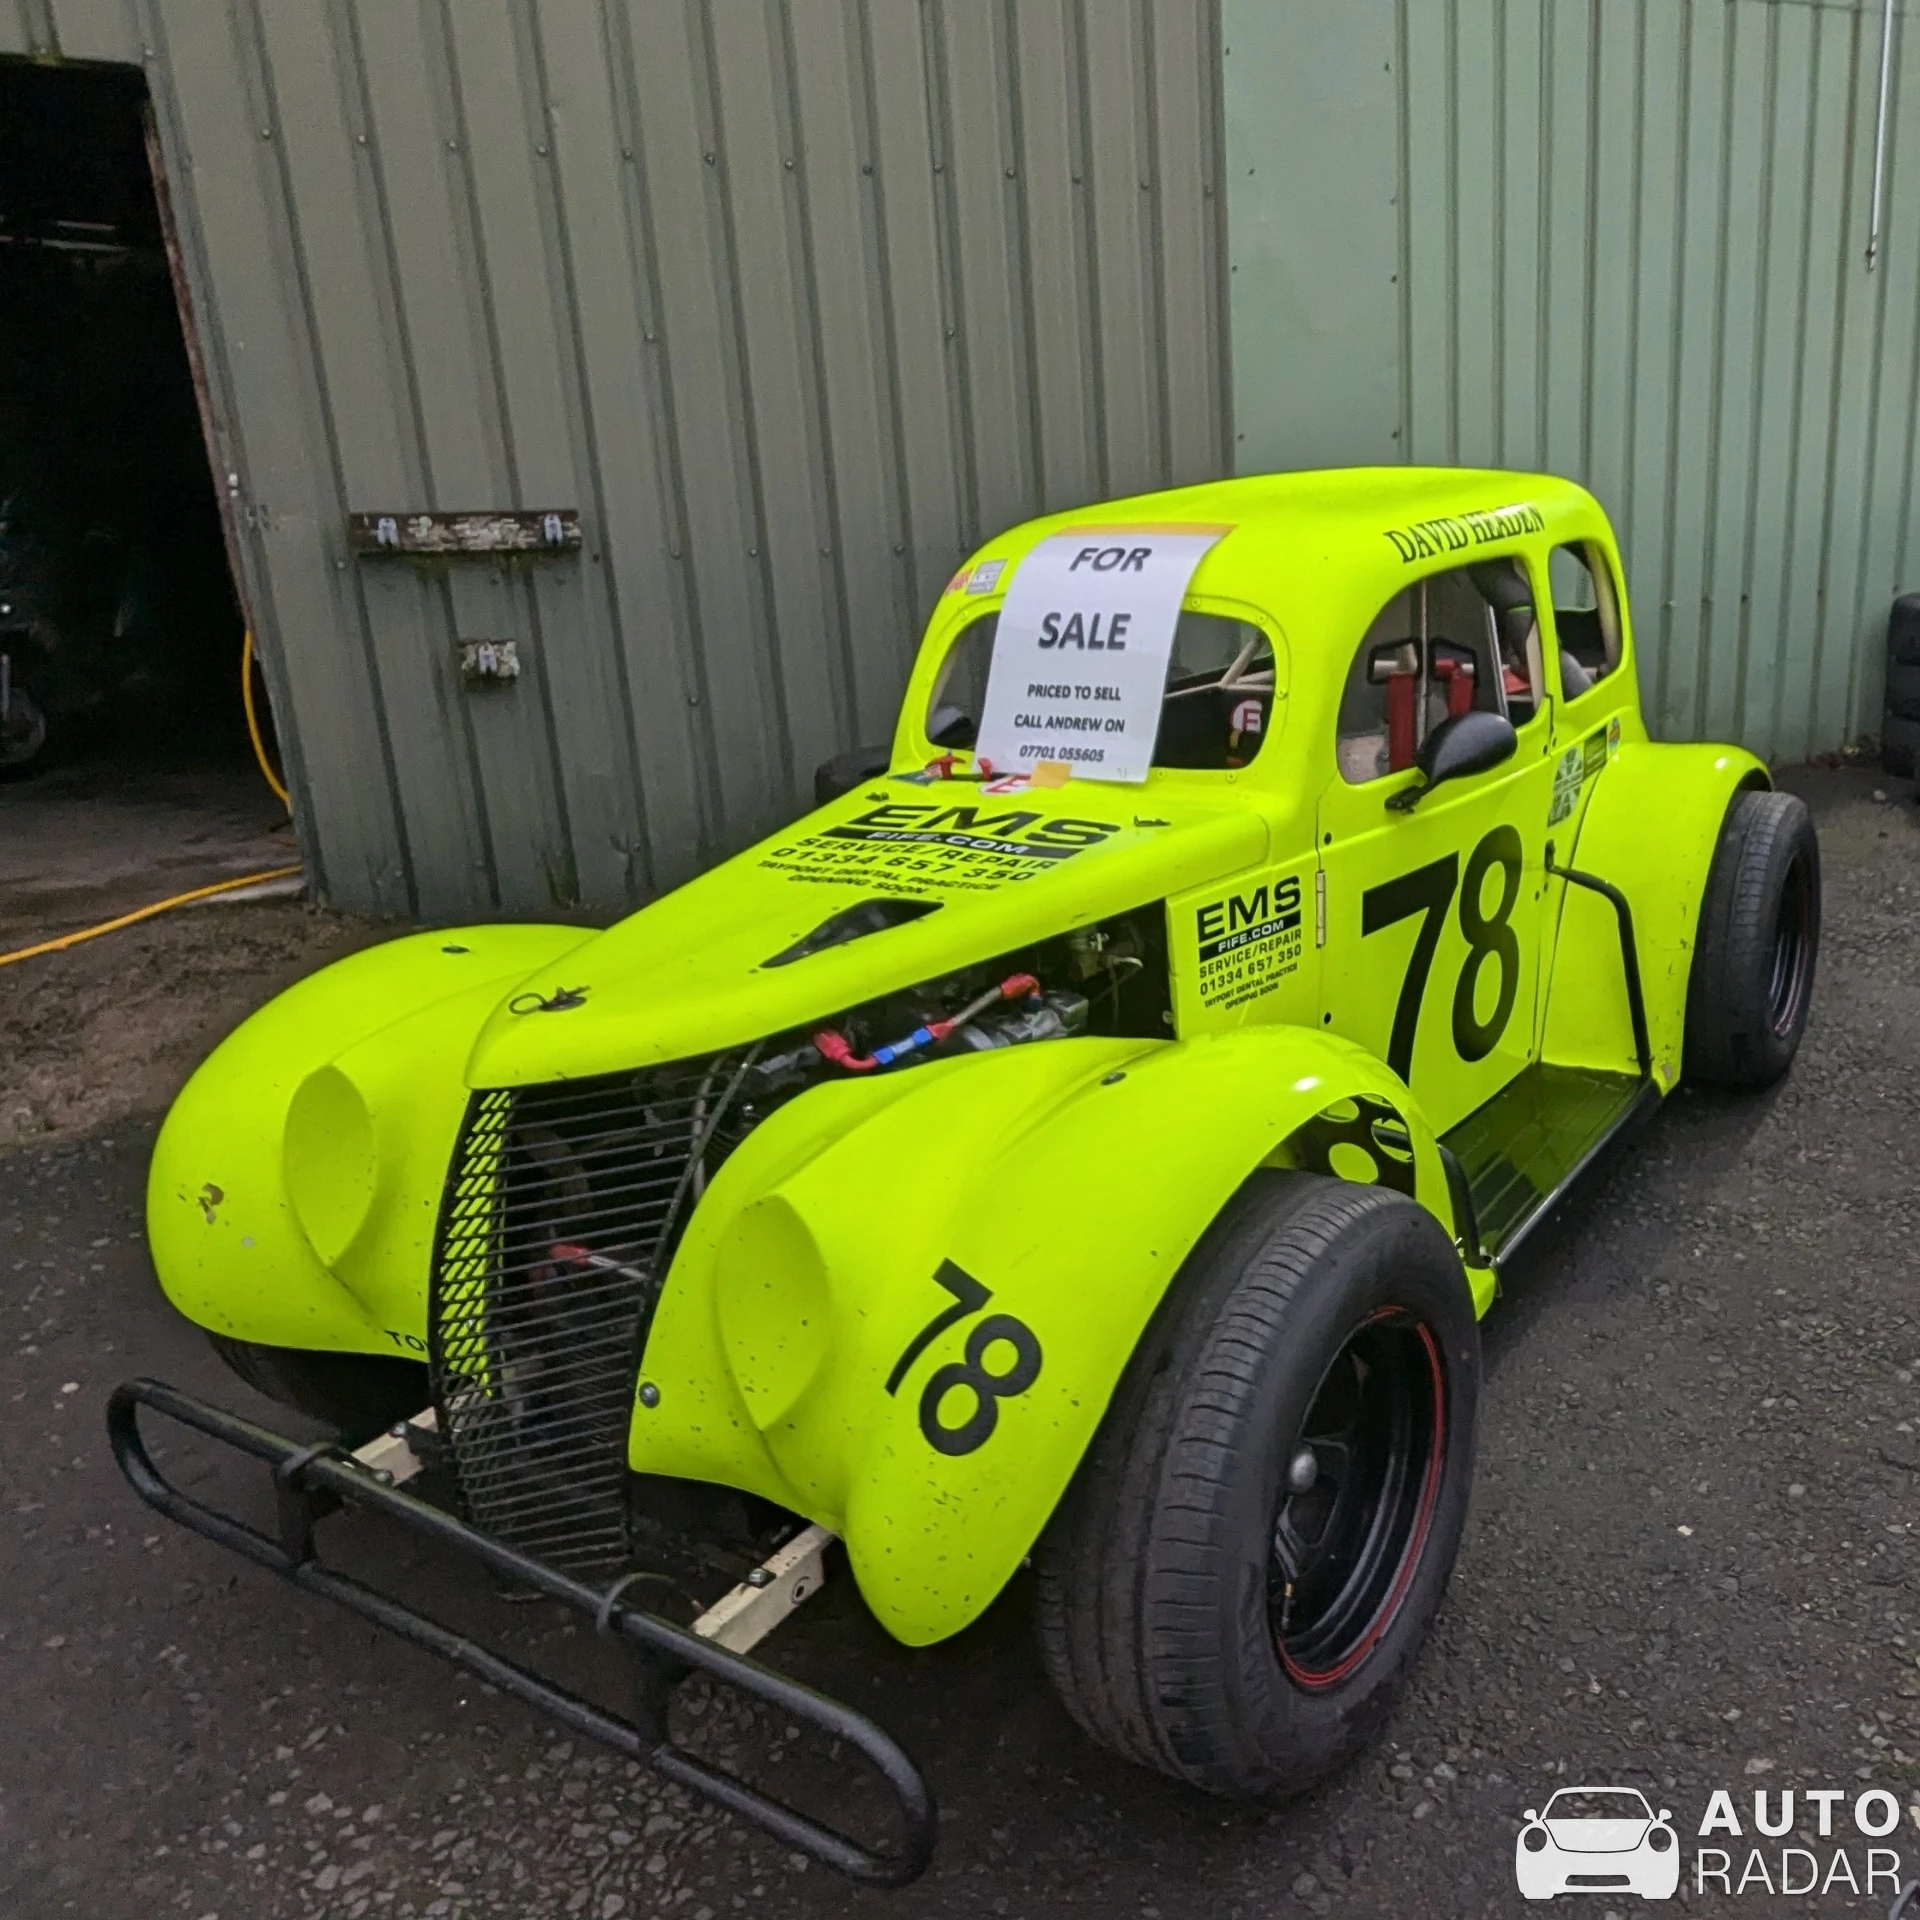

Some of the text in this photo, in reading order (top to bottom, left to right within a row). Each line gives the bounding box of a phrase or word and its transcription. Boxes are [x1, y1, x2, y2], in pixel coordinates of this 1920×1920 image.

[1382, 518, 1468, 563] DAVID
[1069, 547, 1152, 572] FOR
[1038, 612, 1131, 650] SALE
[1027, 684, 1121, 701] PRICED TO SELL
[1014, 714, 1125, 733] CALL ANDREW ON
[1019, 744, 1104, 762] 07701 055605
[846, 804, 1121, 846] EMS
[796, 837, 1058, 869] SERVICE/REPAIR
[866, 831, 1030, 854] FIFE.COM
[771, 848, 1036, 881] 01334 657 350
[1196, 875, 1301, 943] EMS
[1218, 919, 1284, 953] FIFE.COM
[1199, 928, 1302, 979] SERVICE/REPAIR
[1200, 944, 1302, 996] 01334 657 350
[1361, 824, 1523, 1089] 78
[1236, 977, 1264, 993] DENTAL
[384, 1329, 429, 1352] TO
[884, 1257, 1043, 1457] 78
